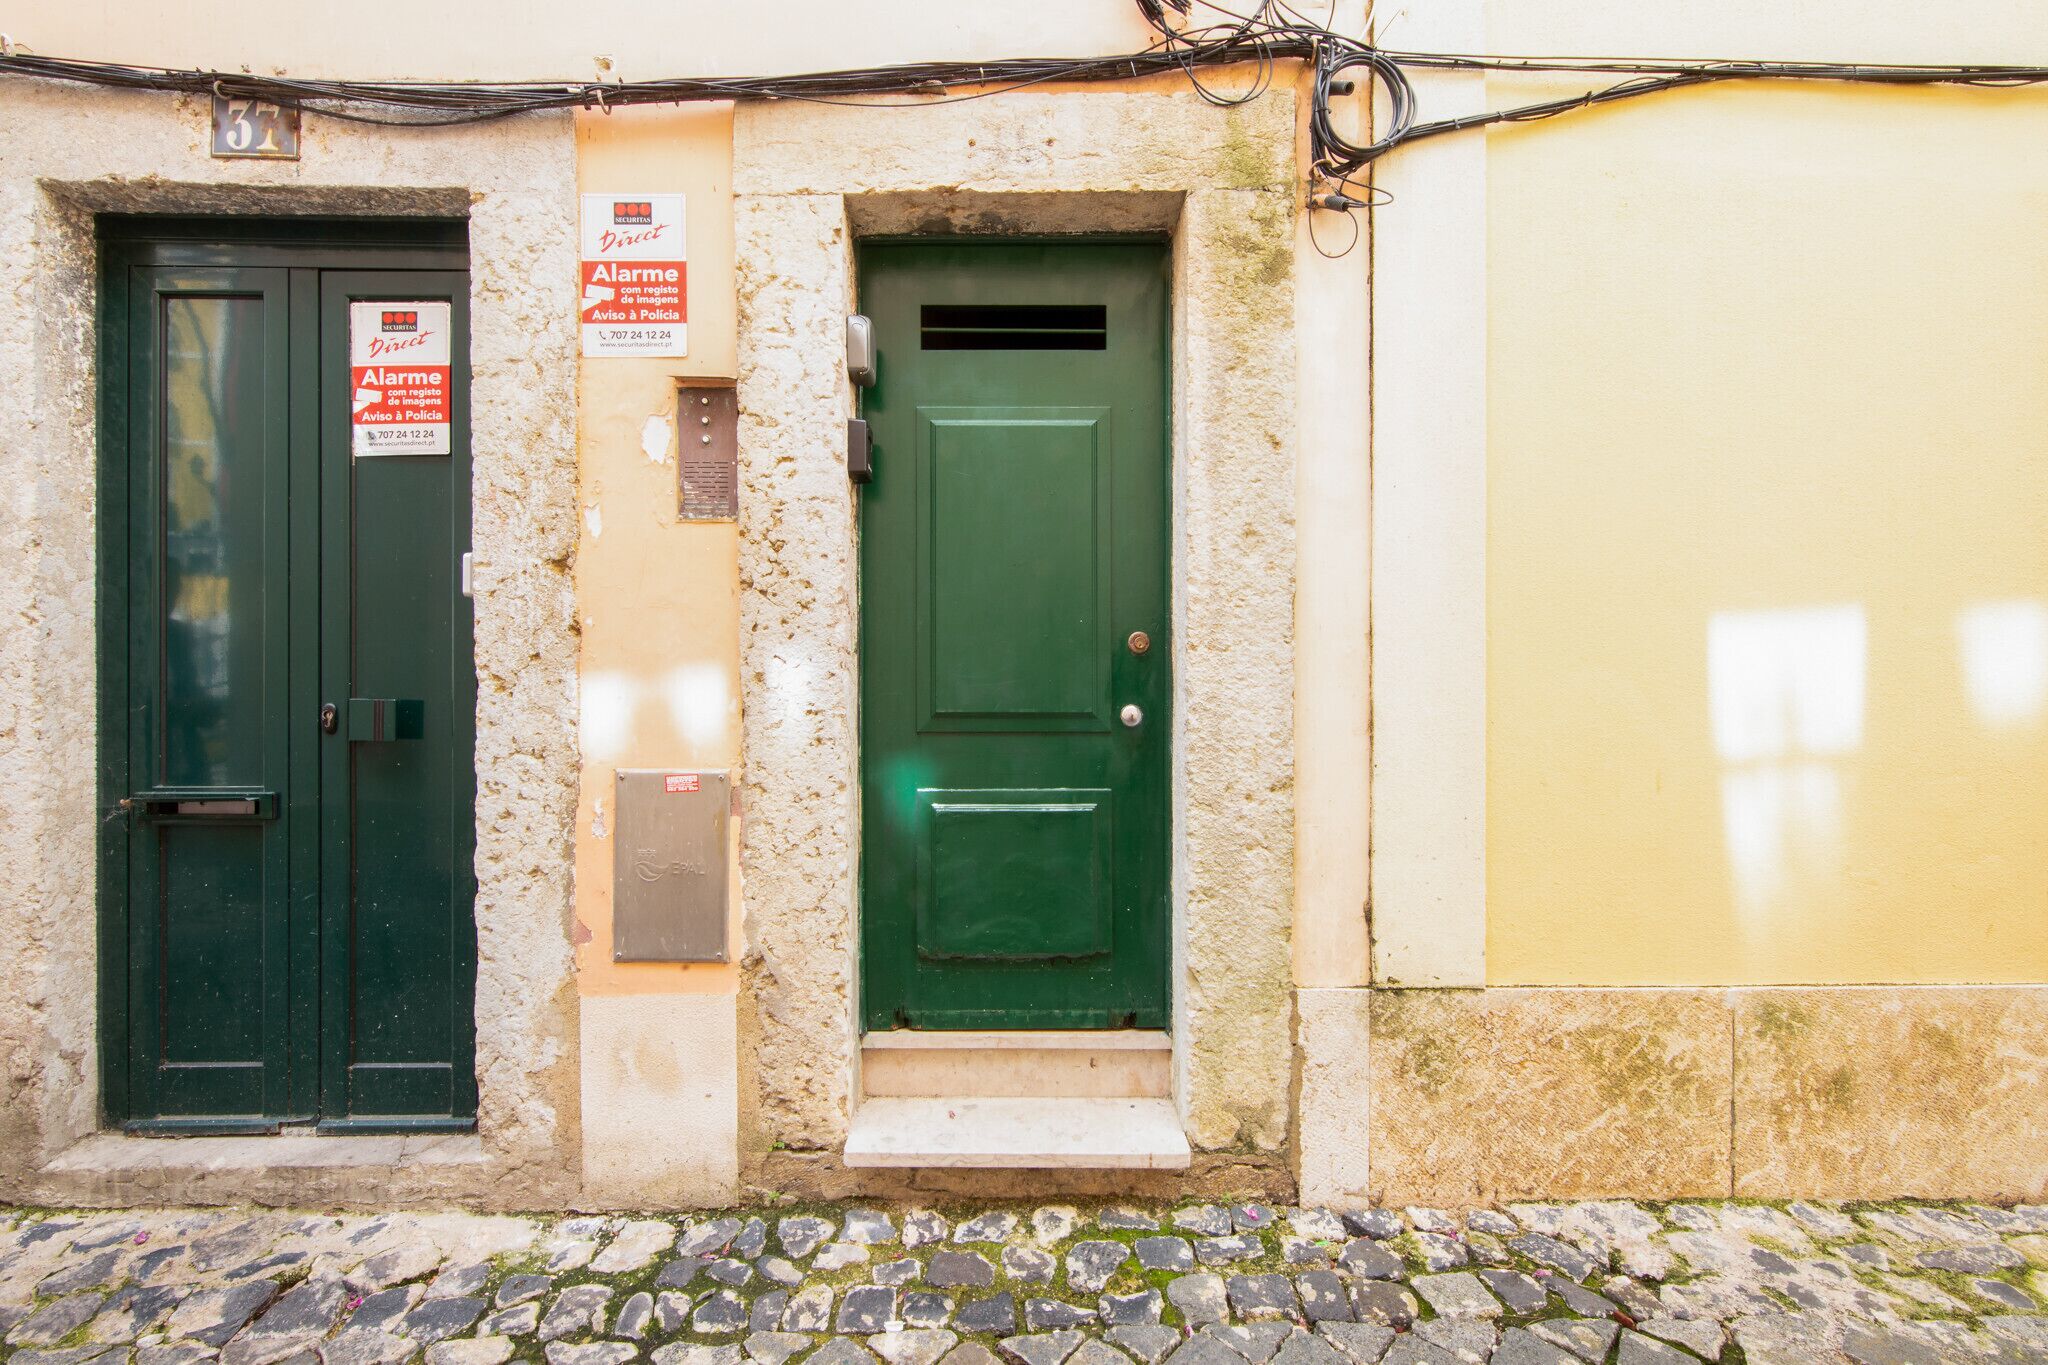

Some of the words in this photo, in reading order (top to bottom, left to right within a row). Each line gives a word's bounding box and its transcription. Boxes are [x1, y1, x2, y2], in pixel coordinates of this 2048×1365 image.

[226, 100, 281, 151] 37
[615, 216, 651, 224] SECURITAS
[599, 223, 671, 253] Direct
[591, 263, 679, 283] Alarme
[620, 286, 641, 294] com
[644, 285, 679, 296] registo
[620, 295, 634, 304] de
[636, 295, 679, 306] imagens
[592, 309, 626, 320] Aviso
[629, 309, 637, 320] à
[640, 309, 680, 320] Polícia
[610, 331, 627, 340] 707
[630, 331, 642, 340] 24
[646, 331, 657, 340] 12
[659, 331, 671, 339] 24
[368, 331, 436, 358] Direct
[361, 368, 442, 386] Alarme
[387, 389, 406, 397] com
[409, 388, 442, 398] registo
[387, 397, 400, 405] de
[402, 397, 442, 407] imagens
[362, 411, 393, 421] Aviso
[396, 410, 402, 421] à
[406, 410, 442, 420] Polícia
[378, 431, 394, 439] 707
[396, 431, 407, 439] 24
[423, 430, 435, 438] 24
